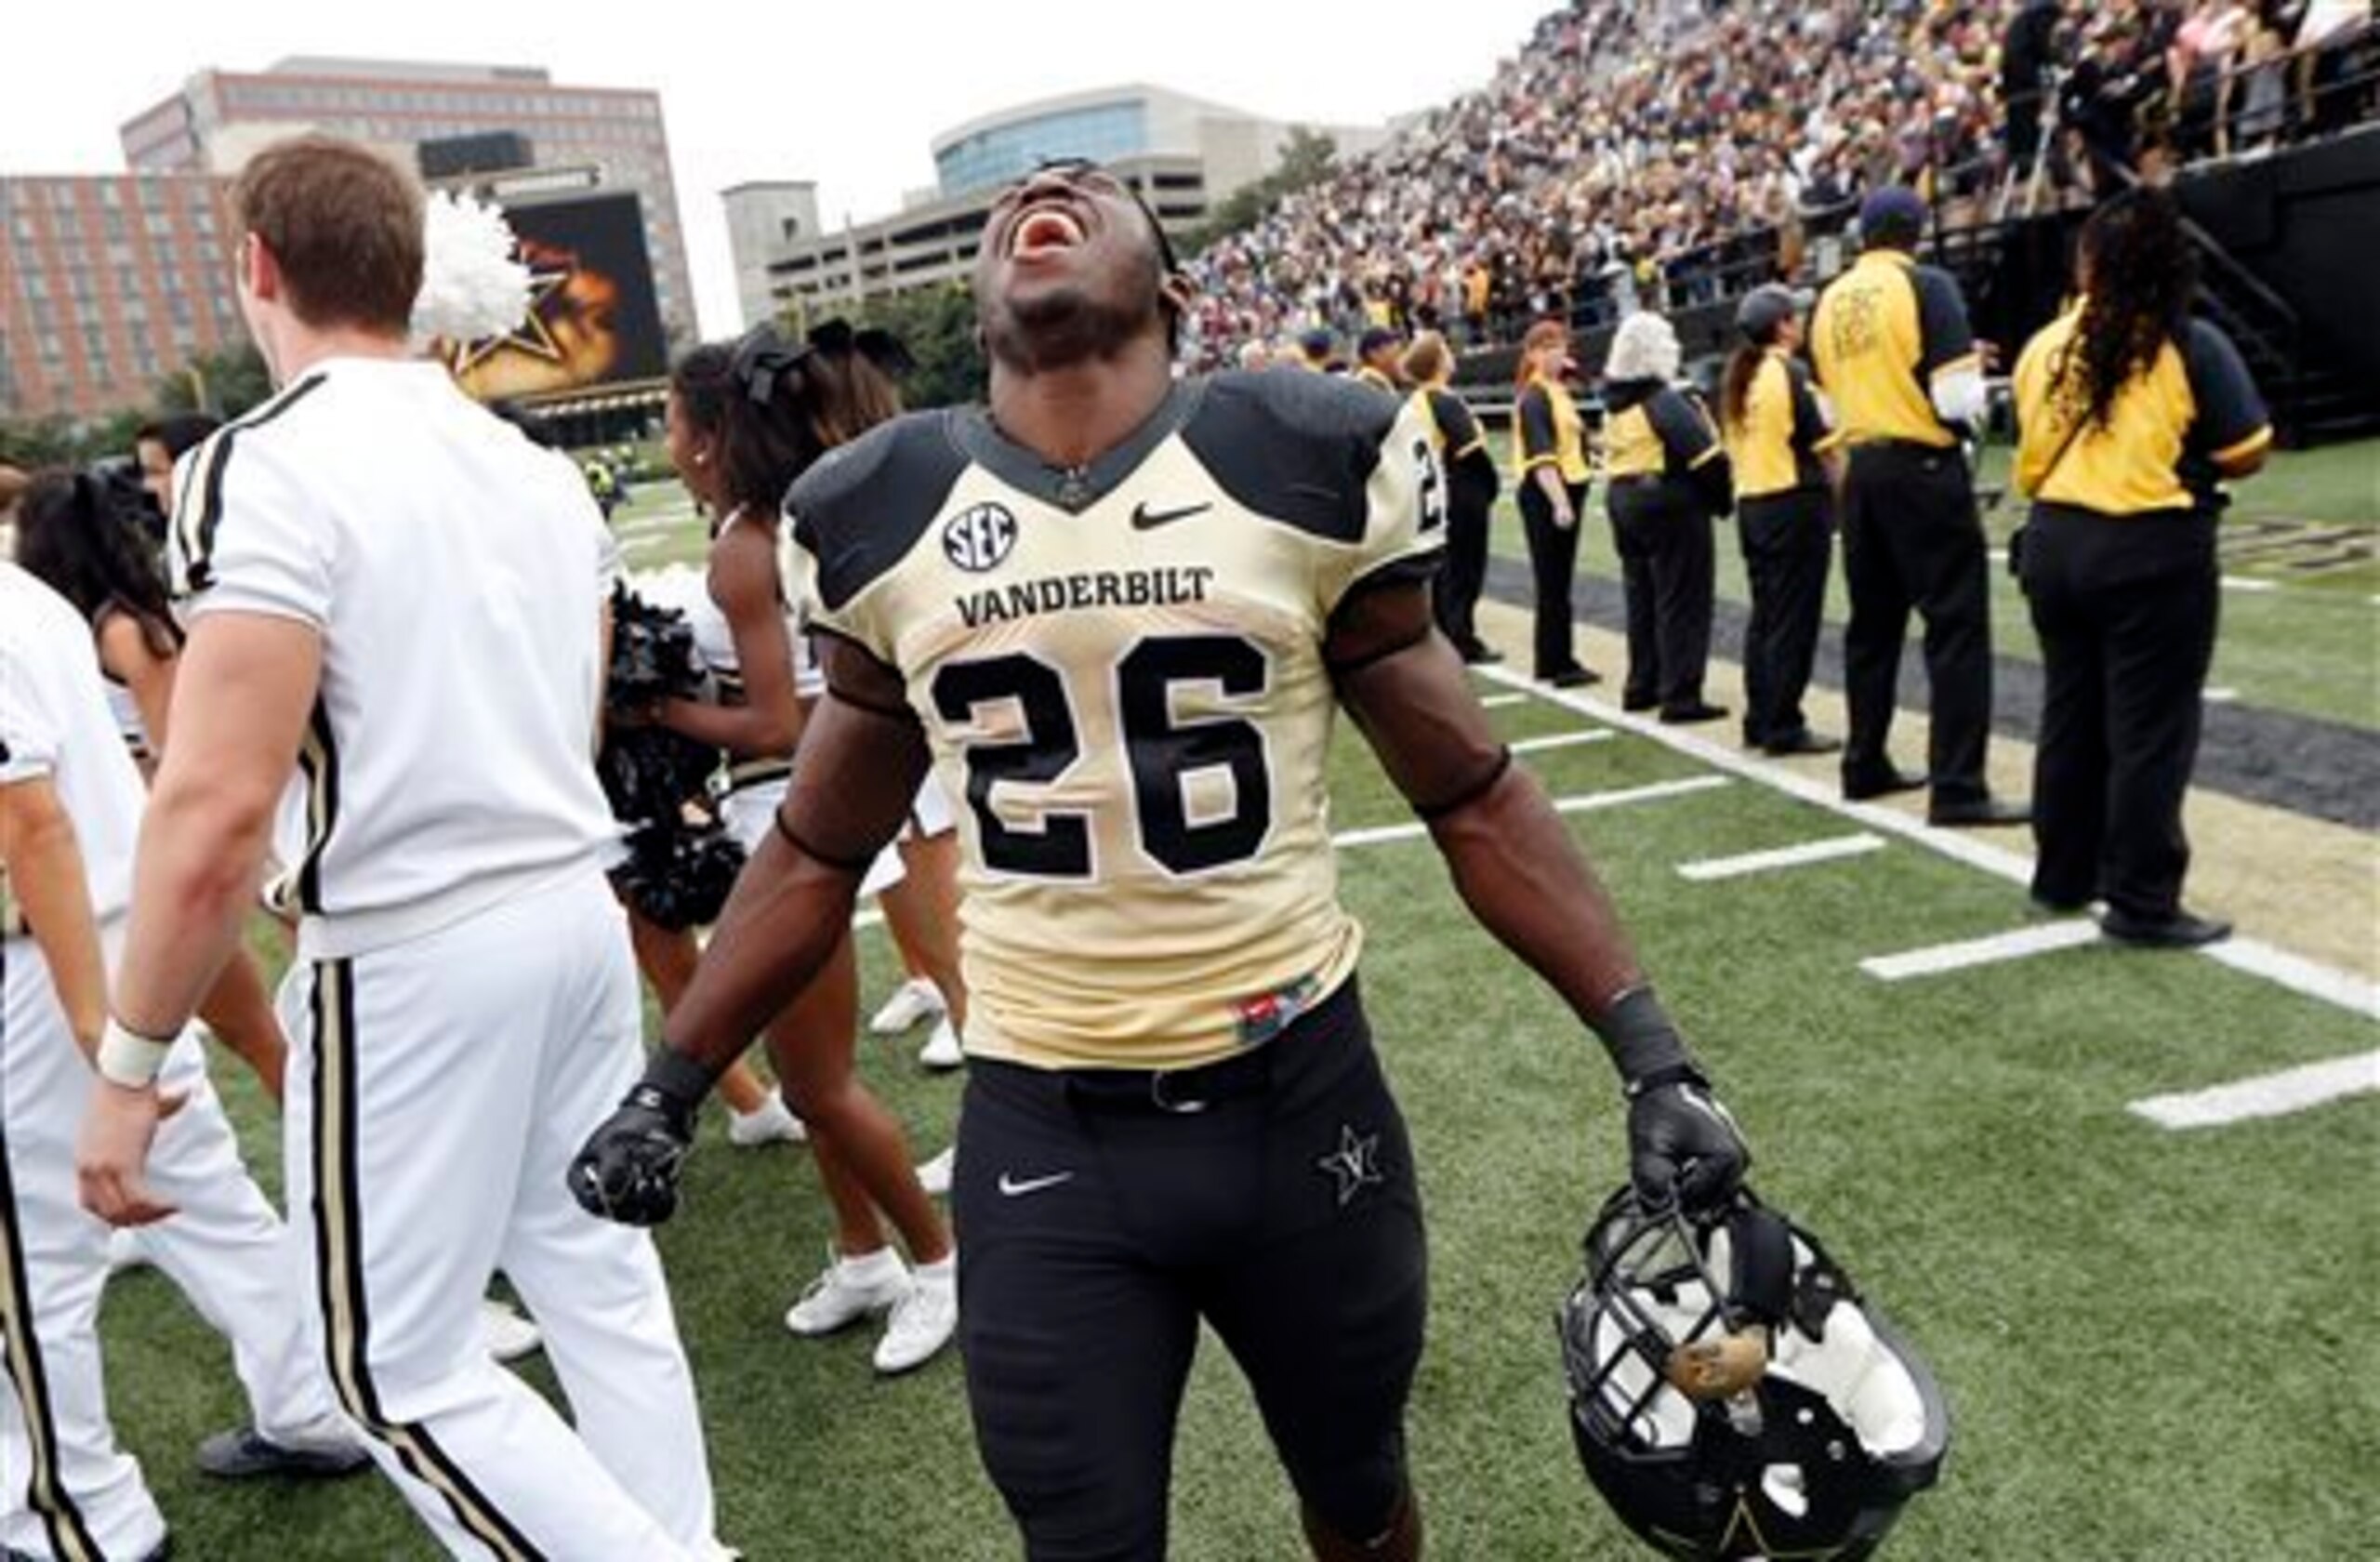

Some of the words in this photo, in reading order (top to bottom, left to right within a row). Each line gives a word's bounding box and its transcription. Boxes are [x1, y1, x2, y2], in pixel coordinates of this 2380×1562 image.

[945, 506, 1013, 571] SEC
[955, 567, 1213, 628] VANDERBILT
[932, 634, 1271, 878] 26
